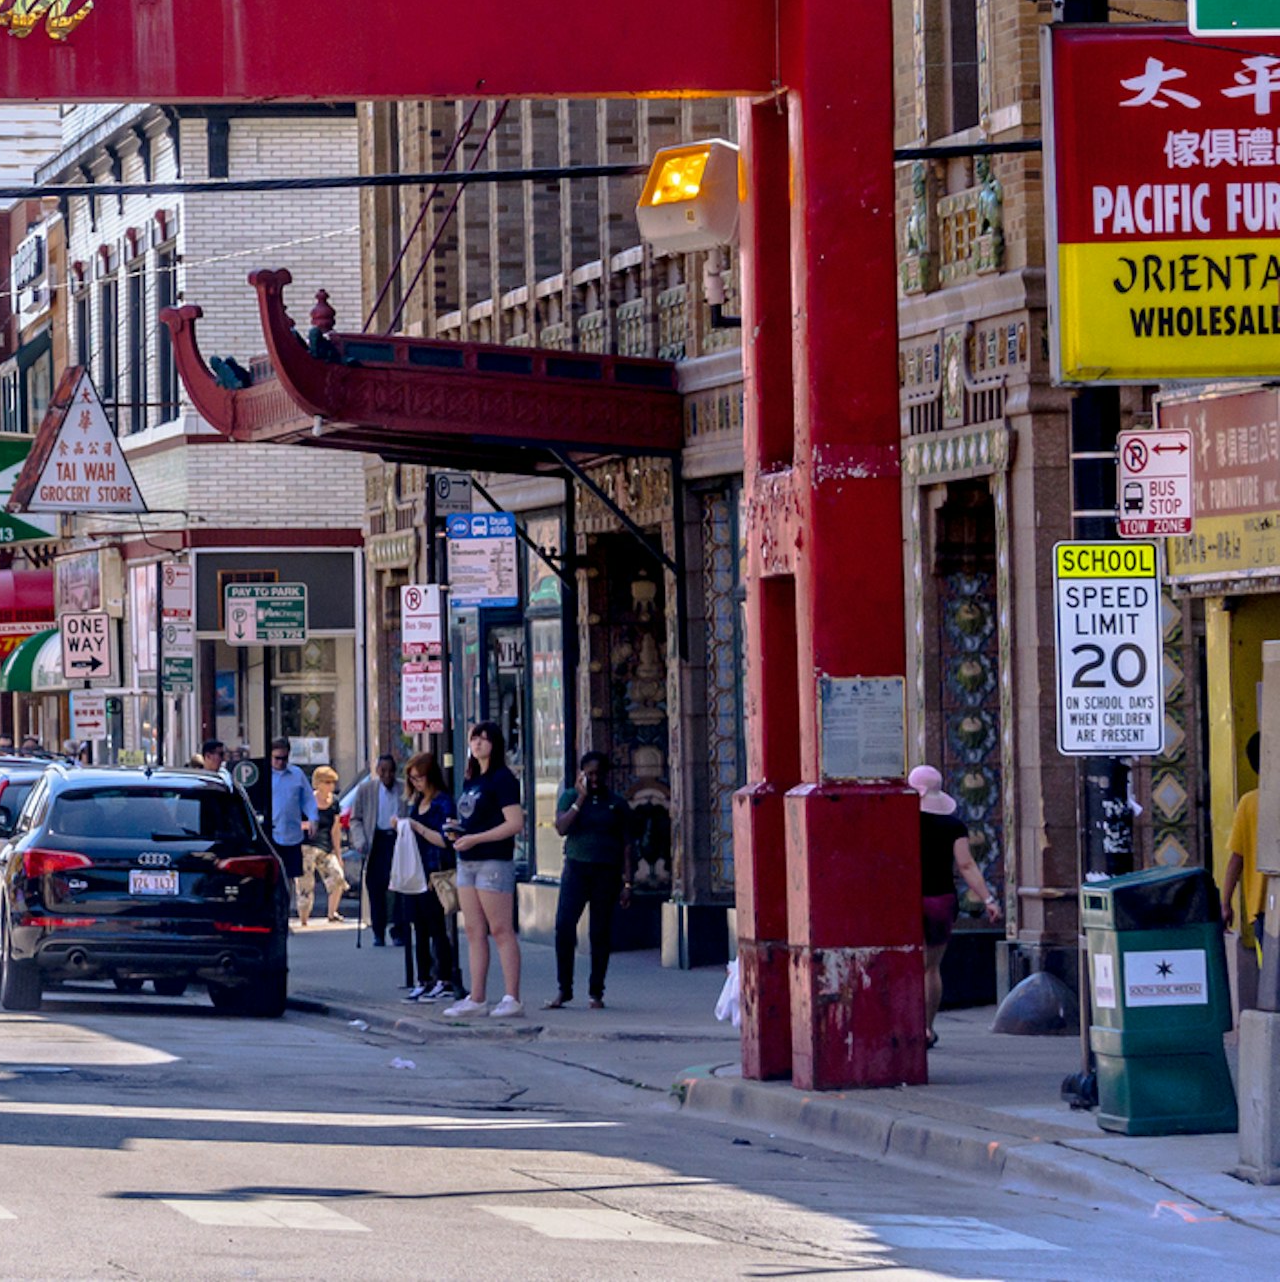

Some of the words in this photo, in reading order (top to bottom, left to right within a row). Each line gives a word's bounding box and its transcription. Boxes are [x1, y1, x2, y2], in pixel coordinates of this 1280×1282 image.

[1163, 127, 1280, 168] 傢俱禮
[1092, 183, 1211, 234] PACIFIC
[56, 462, 76, 482] TAI
[84, 462, 116, 482] WAH
[40, 486, 91, 502] GROCERY
[98, 486, 132, 502] STORE
[1149, 480, 1176, 496] BUS
[1149, 498, 1183, 515] STOP
[489, 516, 509, 526] bus
[1123, 520, 1148, 534] TOW
[1154, 519, 1186, 533] ZONE
[489, 526, 513, 536] stop
[1063, 550, 1152, 571] SCHOOL
[231, 587, 252, 596] PAY
[254, 587, 269, 596] TO
[271, 587, 301, 596] PARK
[1066, 586, 1149, 608] SPEED
[67, 618, 103, 634] ONE
[404, 620, 417, 630] Bus
[1075, 613, 1139, 635] LIMIT
[67, 637, 105, 652] WAY
[1071, 642, 1148, 688] 20
[1066, 696, 1079, 710] ON
[1084, 696, 1124, 710] SCHOOL
[1129, 695, 1154, 710] DAYS
[1070, 712, 1098, 726] WHEN
[1102, 712, 1152, 727] CHILDREN
[1076, 729, 1096, 742] ARE
[1101, 729, 1145, 742] PRESENT
